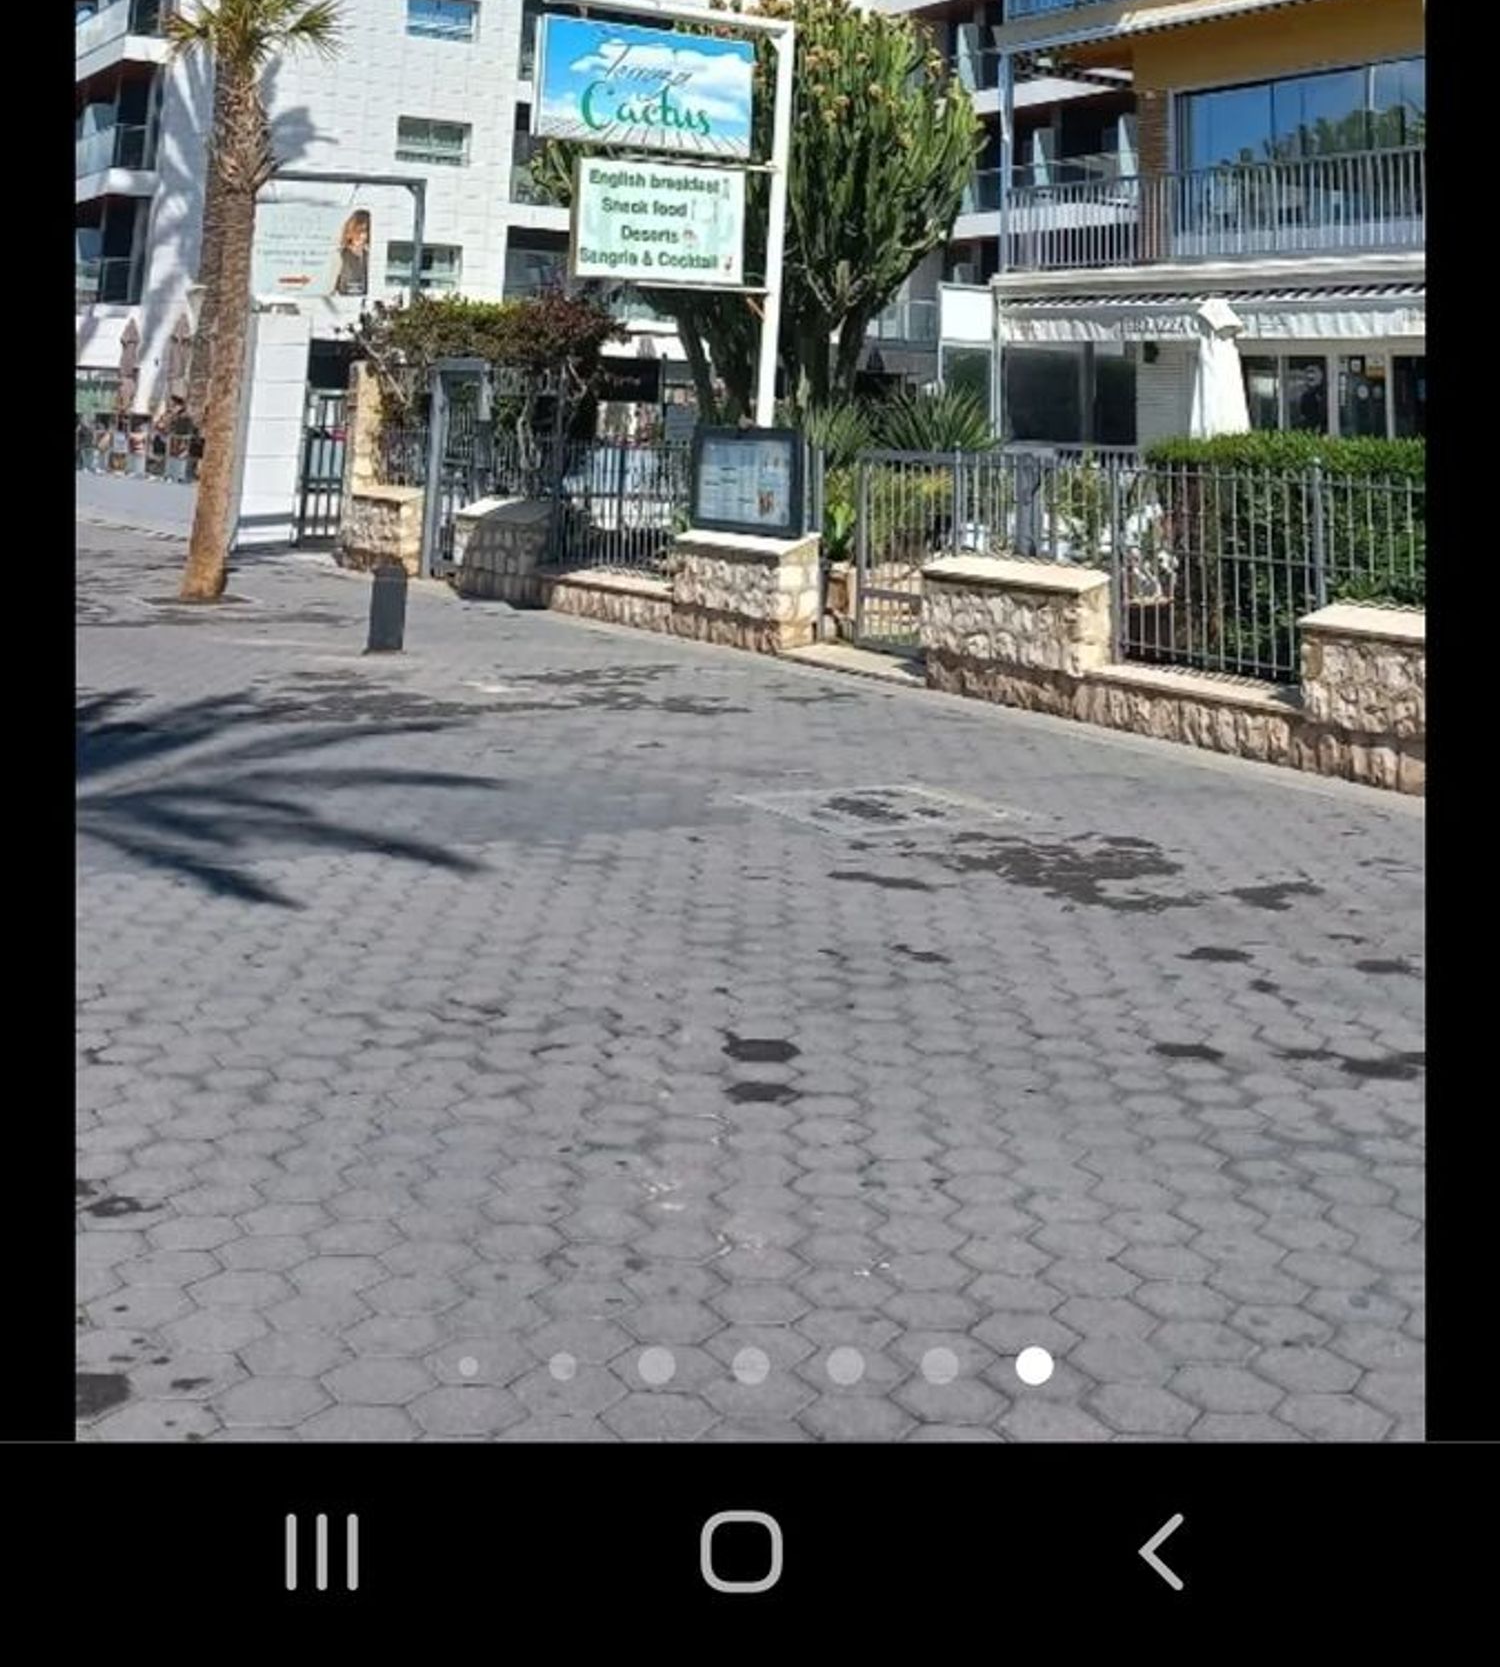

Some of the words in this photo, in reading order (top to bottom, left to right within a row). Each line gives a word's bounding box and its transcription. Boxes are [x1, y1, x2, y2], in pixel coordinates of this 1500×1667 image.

[581, 80, 712, 136] Cactus
[589, 169, 646, 189] English
[650, 173, 720, 194] breakfast
[602, 196, 648, 215] Snack
[653, 200, 687, 218] food
[580, 247, 638, 269] Sangria
[642, 250, 653, 267] &
[658, 251, 719, 270] Cocktail
